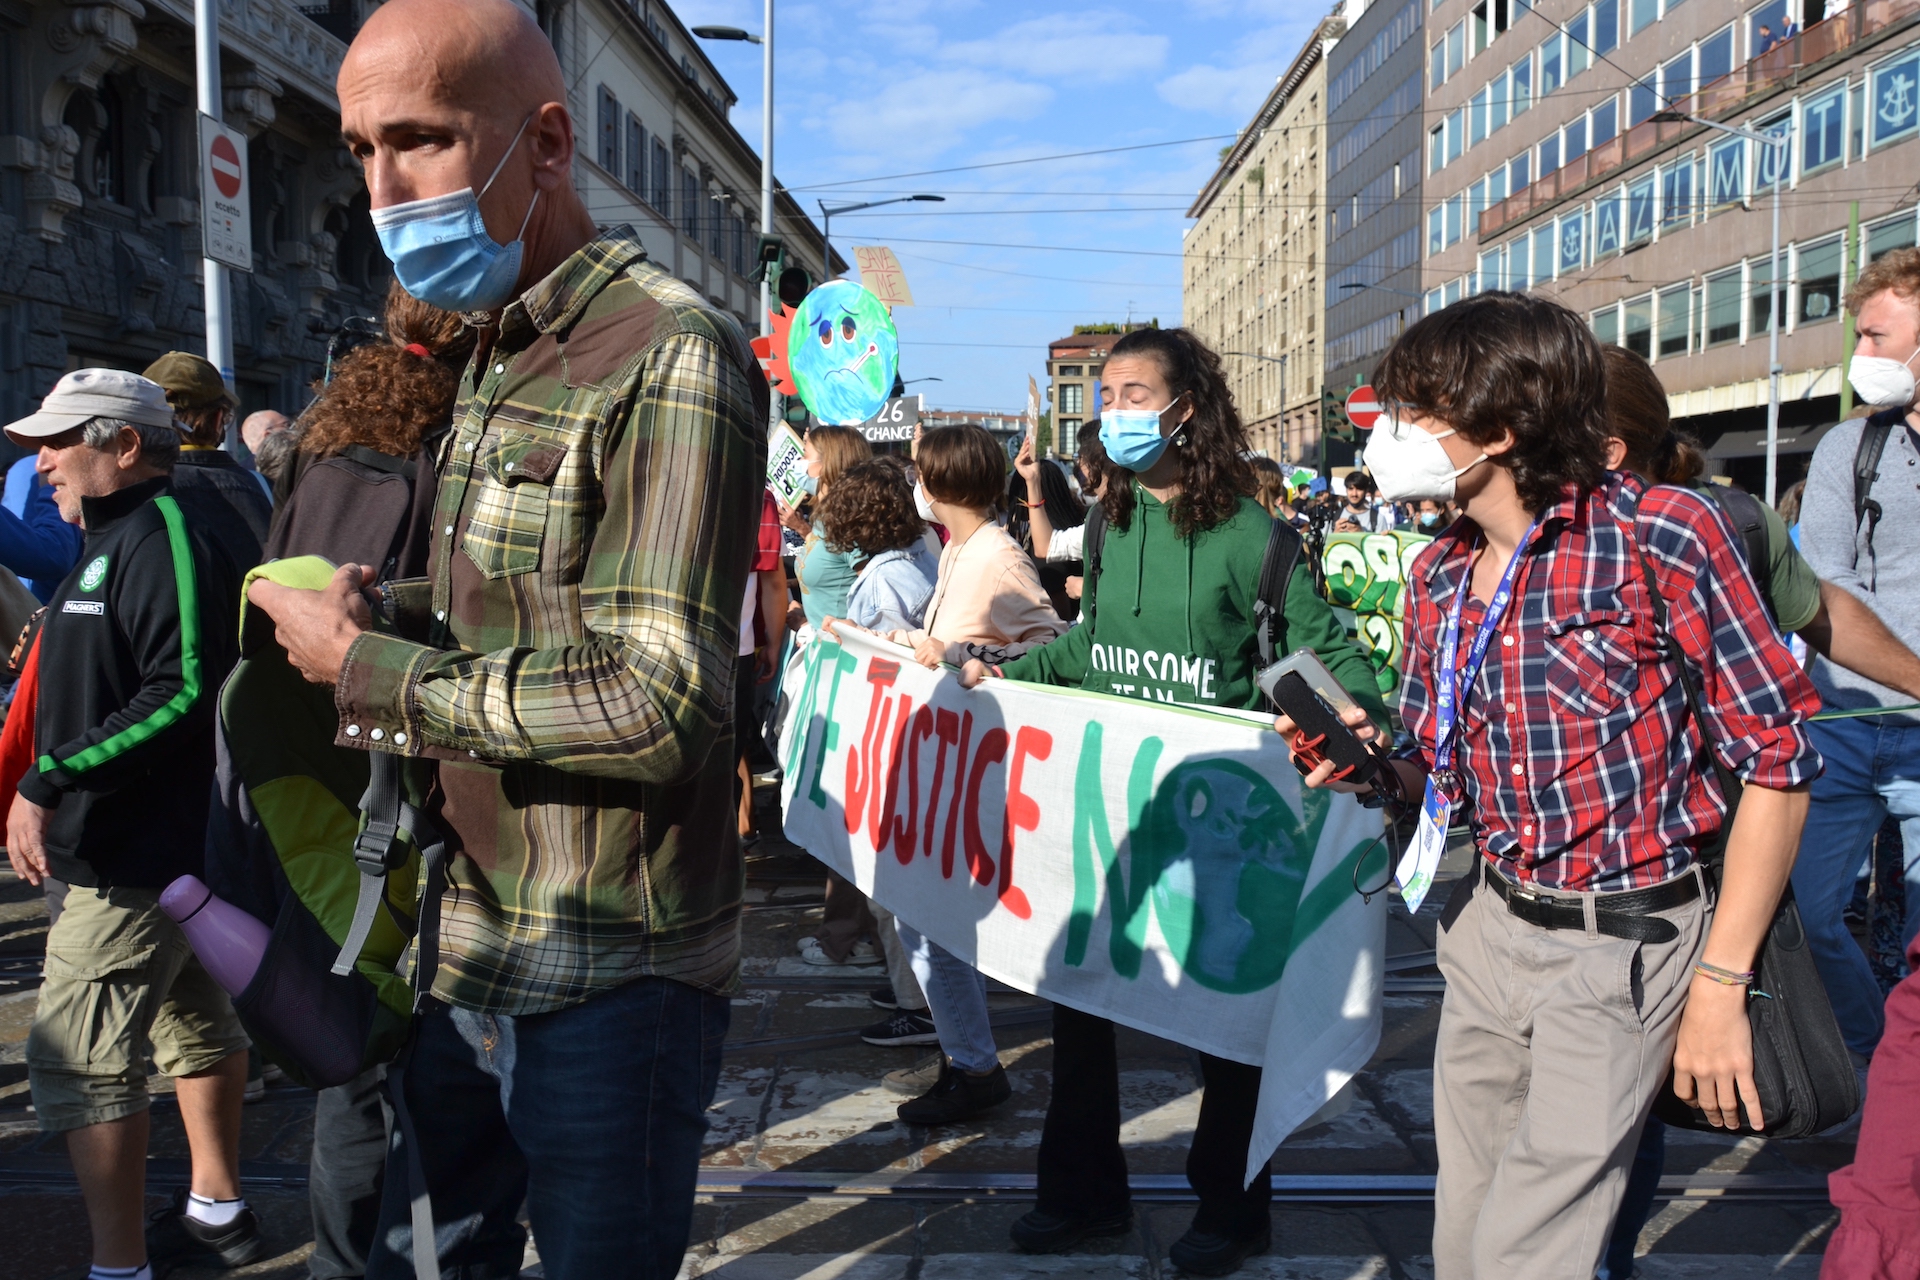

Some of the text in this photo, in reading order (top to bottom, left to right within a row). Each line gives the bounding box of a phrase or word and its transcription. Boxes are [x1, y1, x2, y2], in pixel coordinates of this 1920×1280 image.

[1600, 97, 1835, 252] AZIMUT
[215, 200, 241, 217] eccetto
[857, 246, 896, 270] SAVE
[875, 273, 902, 298] ME
[865, 425, 913, 441] CHANCE
[773, 446, 798, 482] ECOCIDE
[65, 602, 100, 612] MAGNERS
[1085, 643, 1217, 699] OURSOME
[844, 656, 1053, 920] JUSTICE
